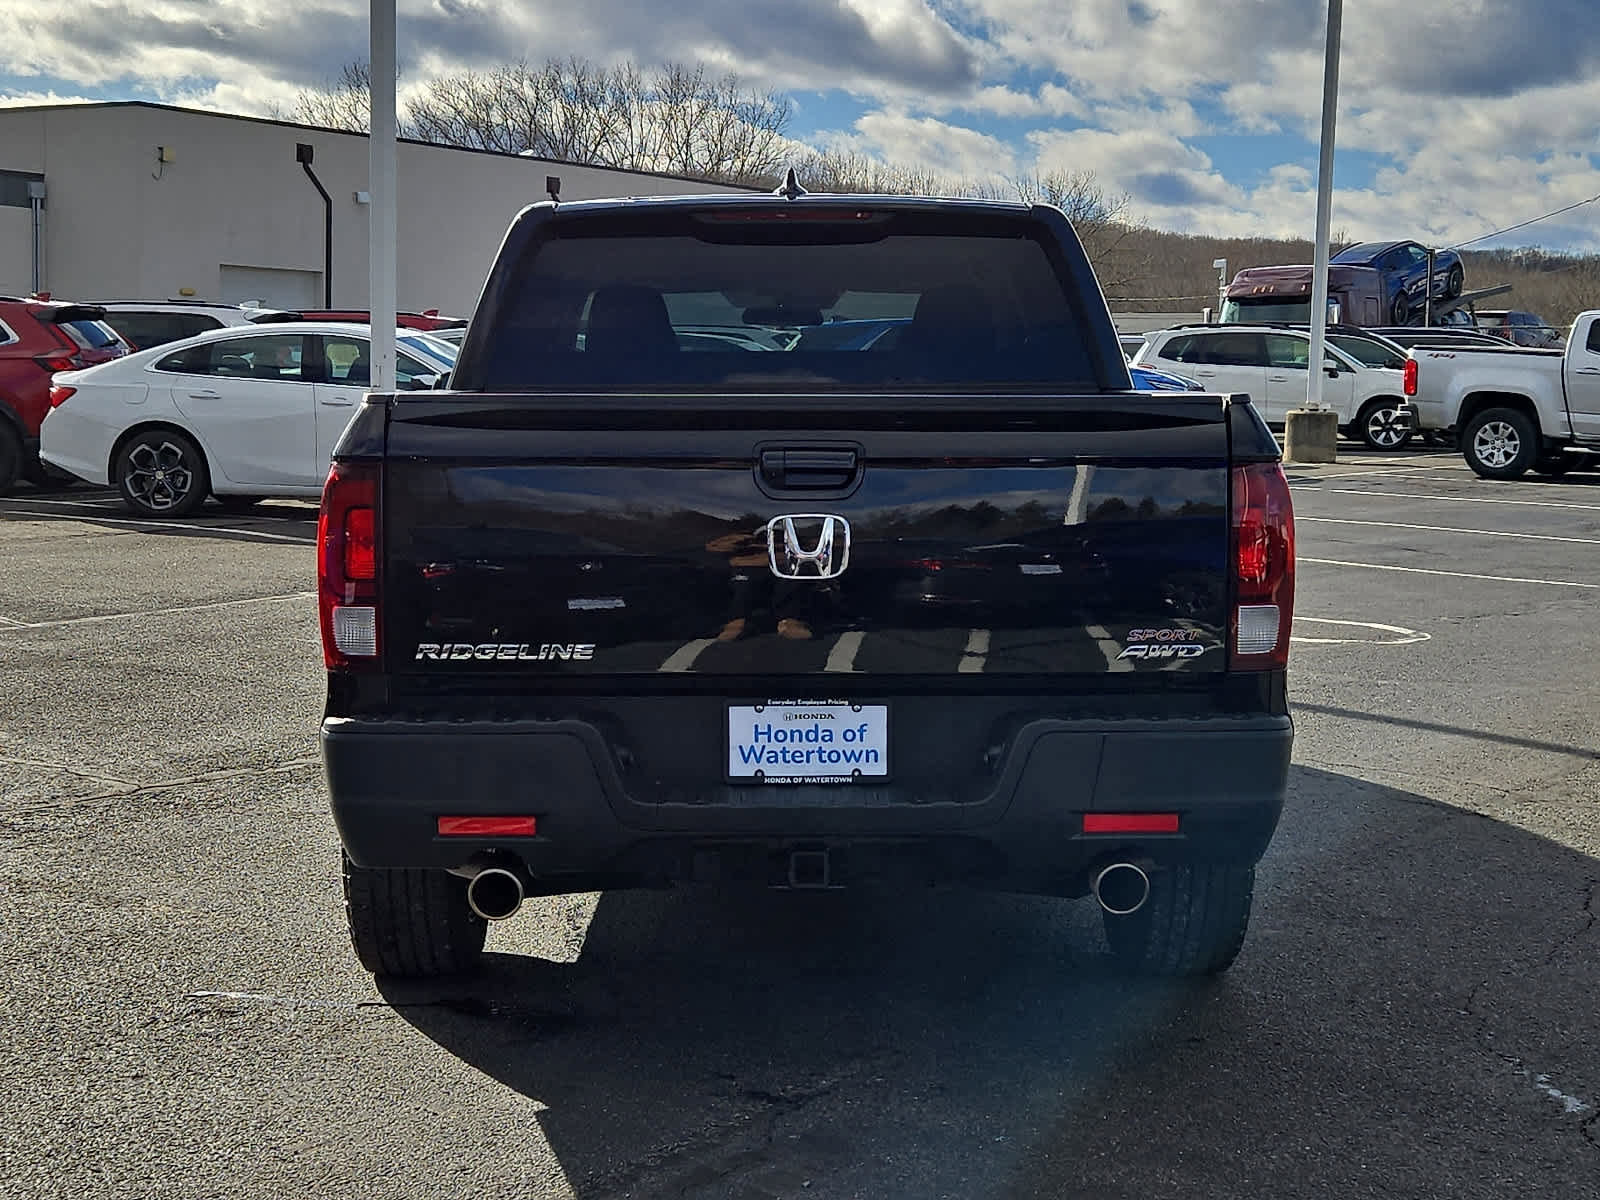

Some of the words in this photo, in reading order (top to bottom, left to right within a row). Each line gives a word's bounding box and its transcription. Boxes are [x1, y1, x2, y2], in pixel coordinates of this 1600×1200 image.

[1126, 629, 1203, 641] SPORT
[415, 643, 596, 660] RIDGELINE
[1115, 644, 1204, 660] AWD
[754, 723, 834, 743] Honda
[842, 723, 868, 743] of
[738, 744, 879, 764] Watertown
